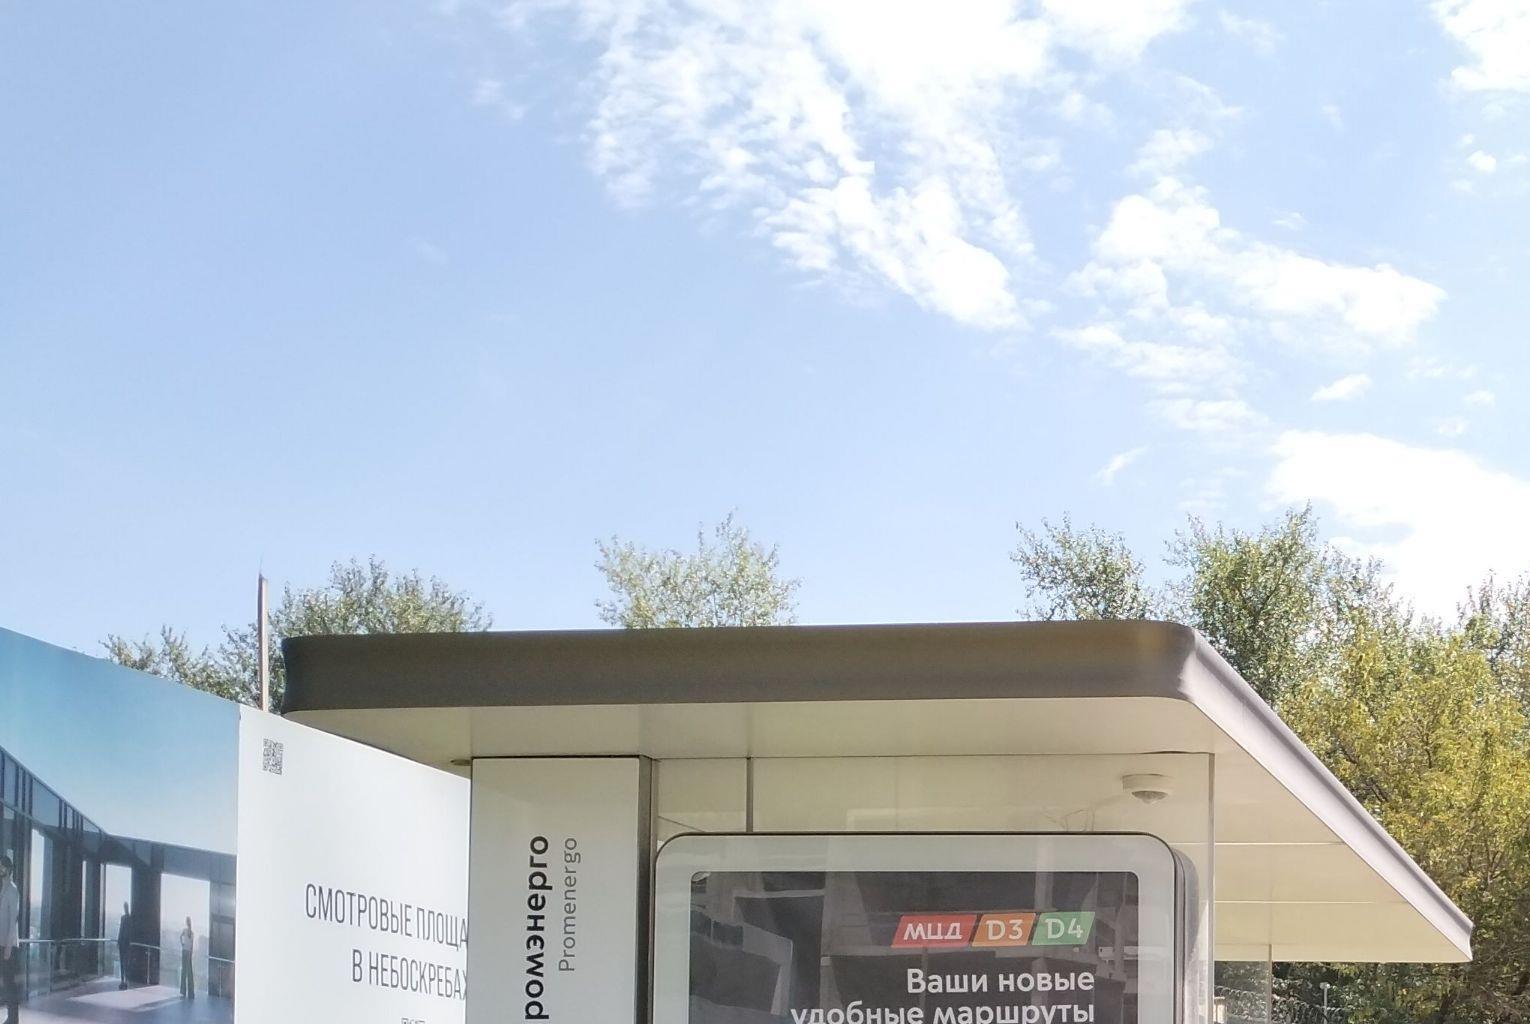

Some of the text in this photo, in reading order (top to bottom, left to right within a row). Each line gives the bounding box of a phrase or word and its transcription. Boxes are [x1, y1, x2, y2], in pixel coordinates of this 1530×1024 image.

[305, 883, 468, 951] СМОТРОВЫЕ ПЛОЩА
[558, 837, 581, 972] Promenergo
[903, 918, 1083, 940] МЦД D3 D4
[352, 949, 363, 983] В
[906, 968, 1095, 993] Ваши новые
